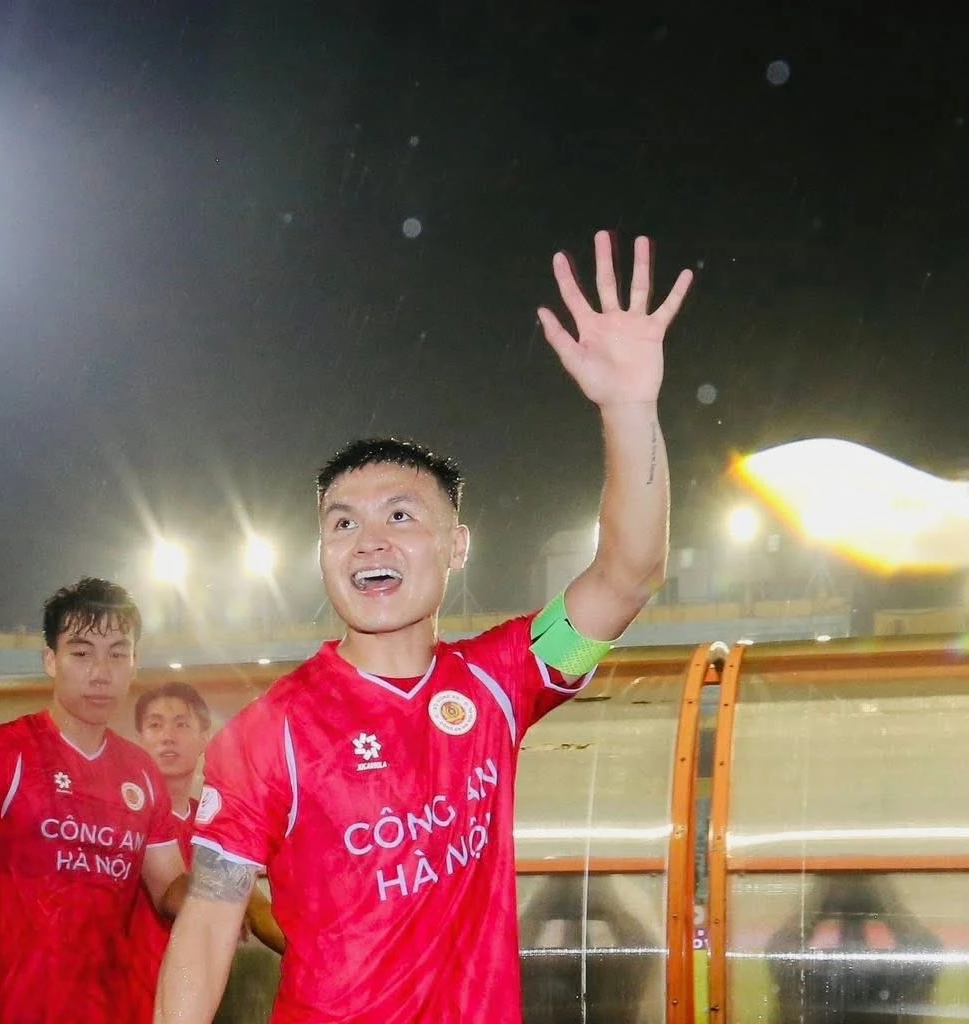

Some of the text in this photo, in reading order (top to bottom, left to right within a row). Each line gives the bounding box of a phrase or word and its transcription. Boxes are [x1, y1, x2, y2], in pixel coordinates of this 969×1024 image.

[344, 758, 498, 856] CÔNG AN
[41, 815, 145, 851] CÔNG AN
[56, 847, 131, 882] HÀ NỘI
[377, 849, 439, 901] HÀ
